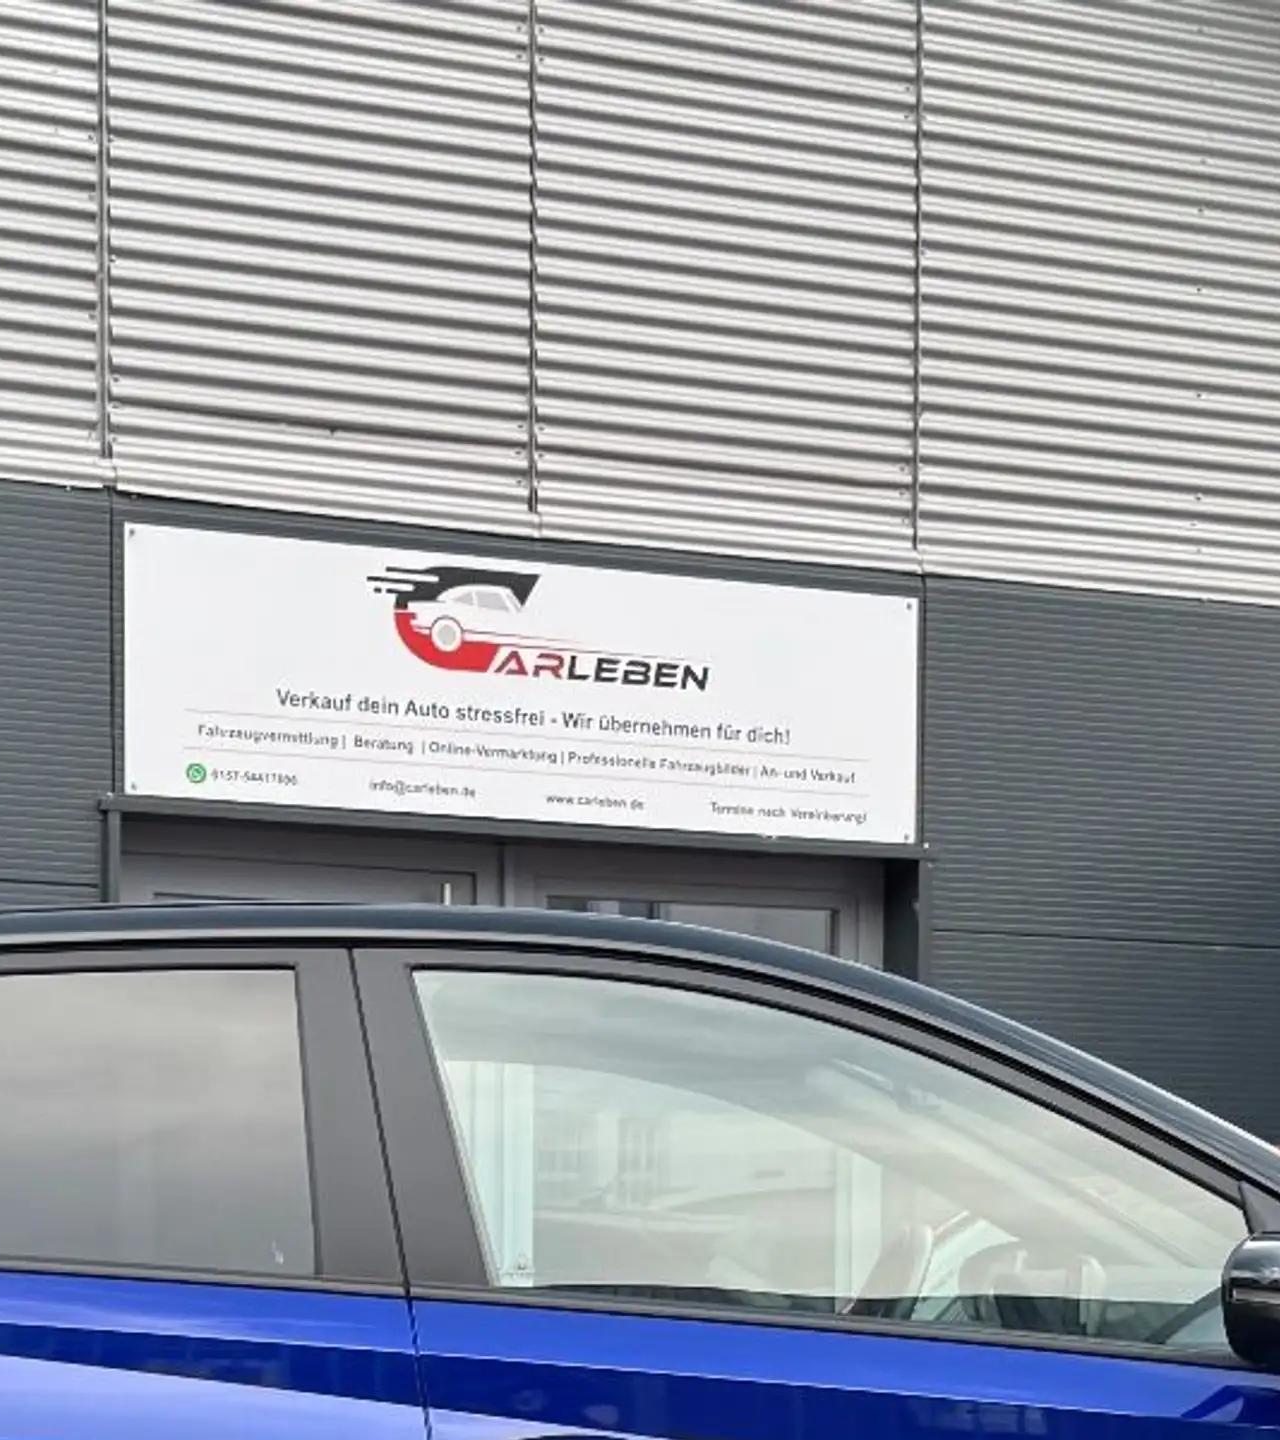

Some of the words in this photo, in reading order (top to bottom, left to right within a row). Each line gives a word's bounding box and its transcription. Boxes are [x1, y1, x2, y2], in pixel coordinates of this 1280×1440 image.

[277, 688, 352, 712] Verkauf
[357, 699, 399, 716] dein
[405, 700, 449, 720] Auto
[455, 706, 545, 727] stressfrei
[562, 710, 594, 730] Wir
[599, 713, 711, 739] übernehmen
[716, 722, 741, 742] für
[747, 725, 791, 746] dich!
[198, 724, 338, 749] Fahrzeugvermittlung
[354, 734, 414, 755] Beratung
[428, 740, 558, 765] Online-Vermarktung
[568, 750, 656, 770] Professionelle
[659, 757, 750, 777] Fahrzeugbilder
[784, 768, 807, 781] und
[810, 769, 855, 784] Verkauf
[710, 800, 755, 815] Termine
[758, 807, 786, 818] nach
